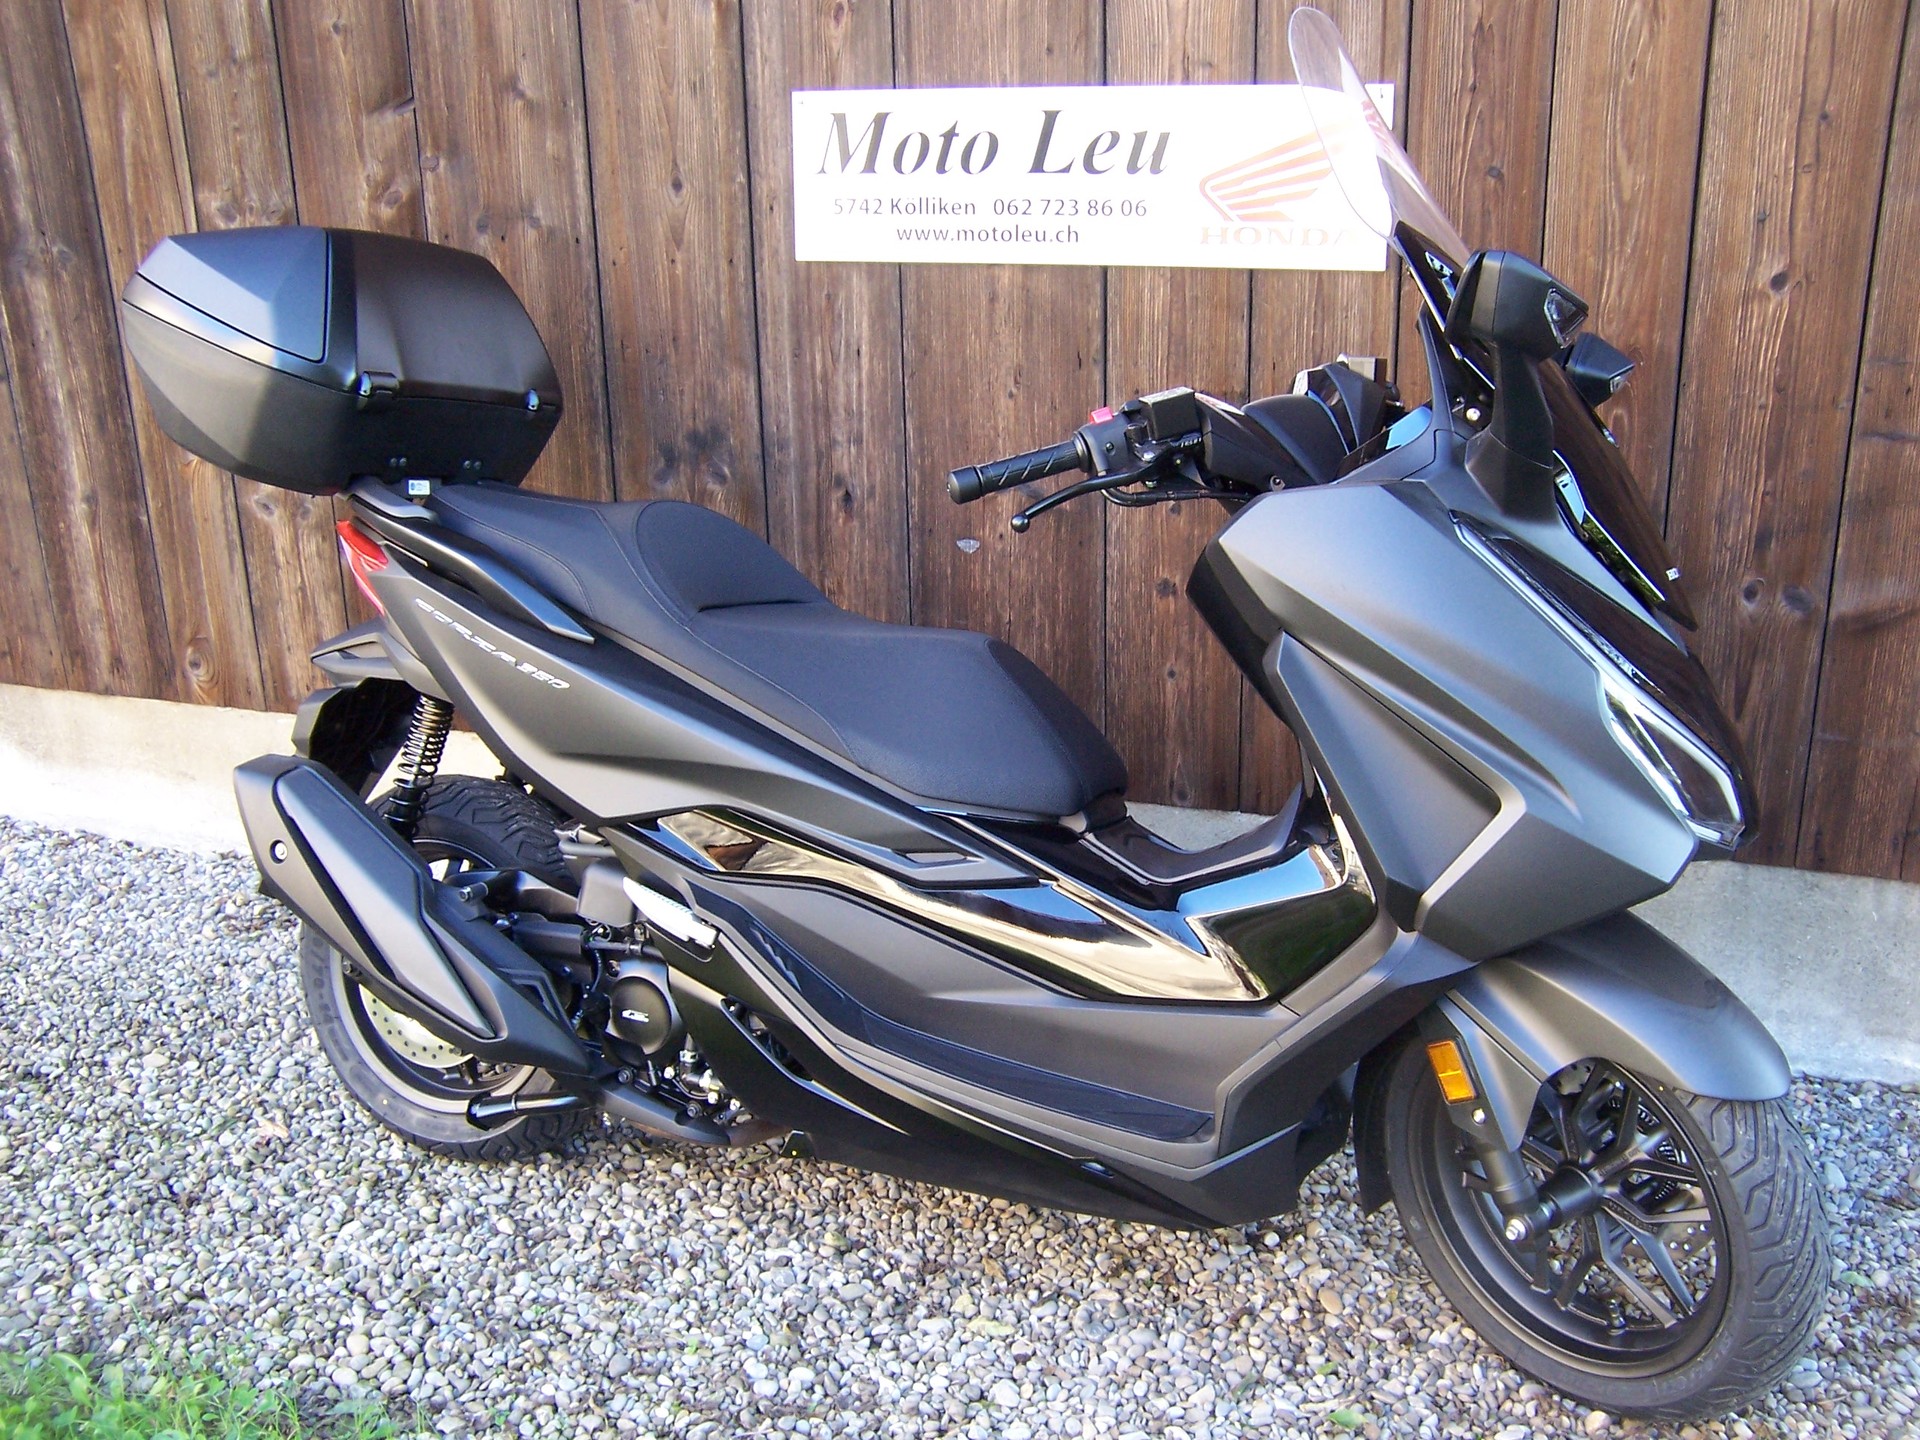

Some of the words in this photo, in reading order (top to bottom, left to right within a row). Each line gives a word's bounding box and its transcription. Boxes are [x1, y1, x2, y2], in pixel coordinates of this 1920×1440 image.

[816, 111, 999, 175] Moto
[1027, 110, 1171, 175] Leu
[832, 198, 883, 215] 5742
[889, 196, 976, 216] Kölliken
[993, 198, 1032, 216] 062
[1040, 198, 1079, 217] 723
[1087, 199, 1113, 217] 86
[1120, 199, 1147, 217] 06
[896, 224, 1079, 243] www.motoleu.ch
